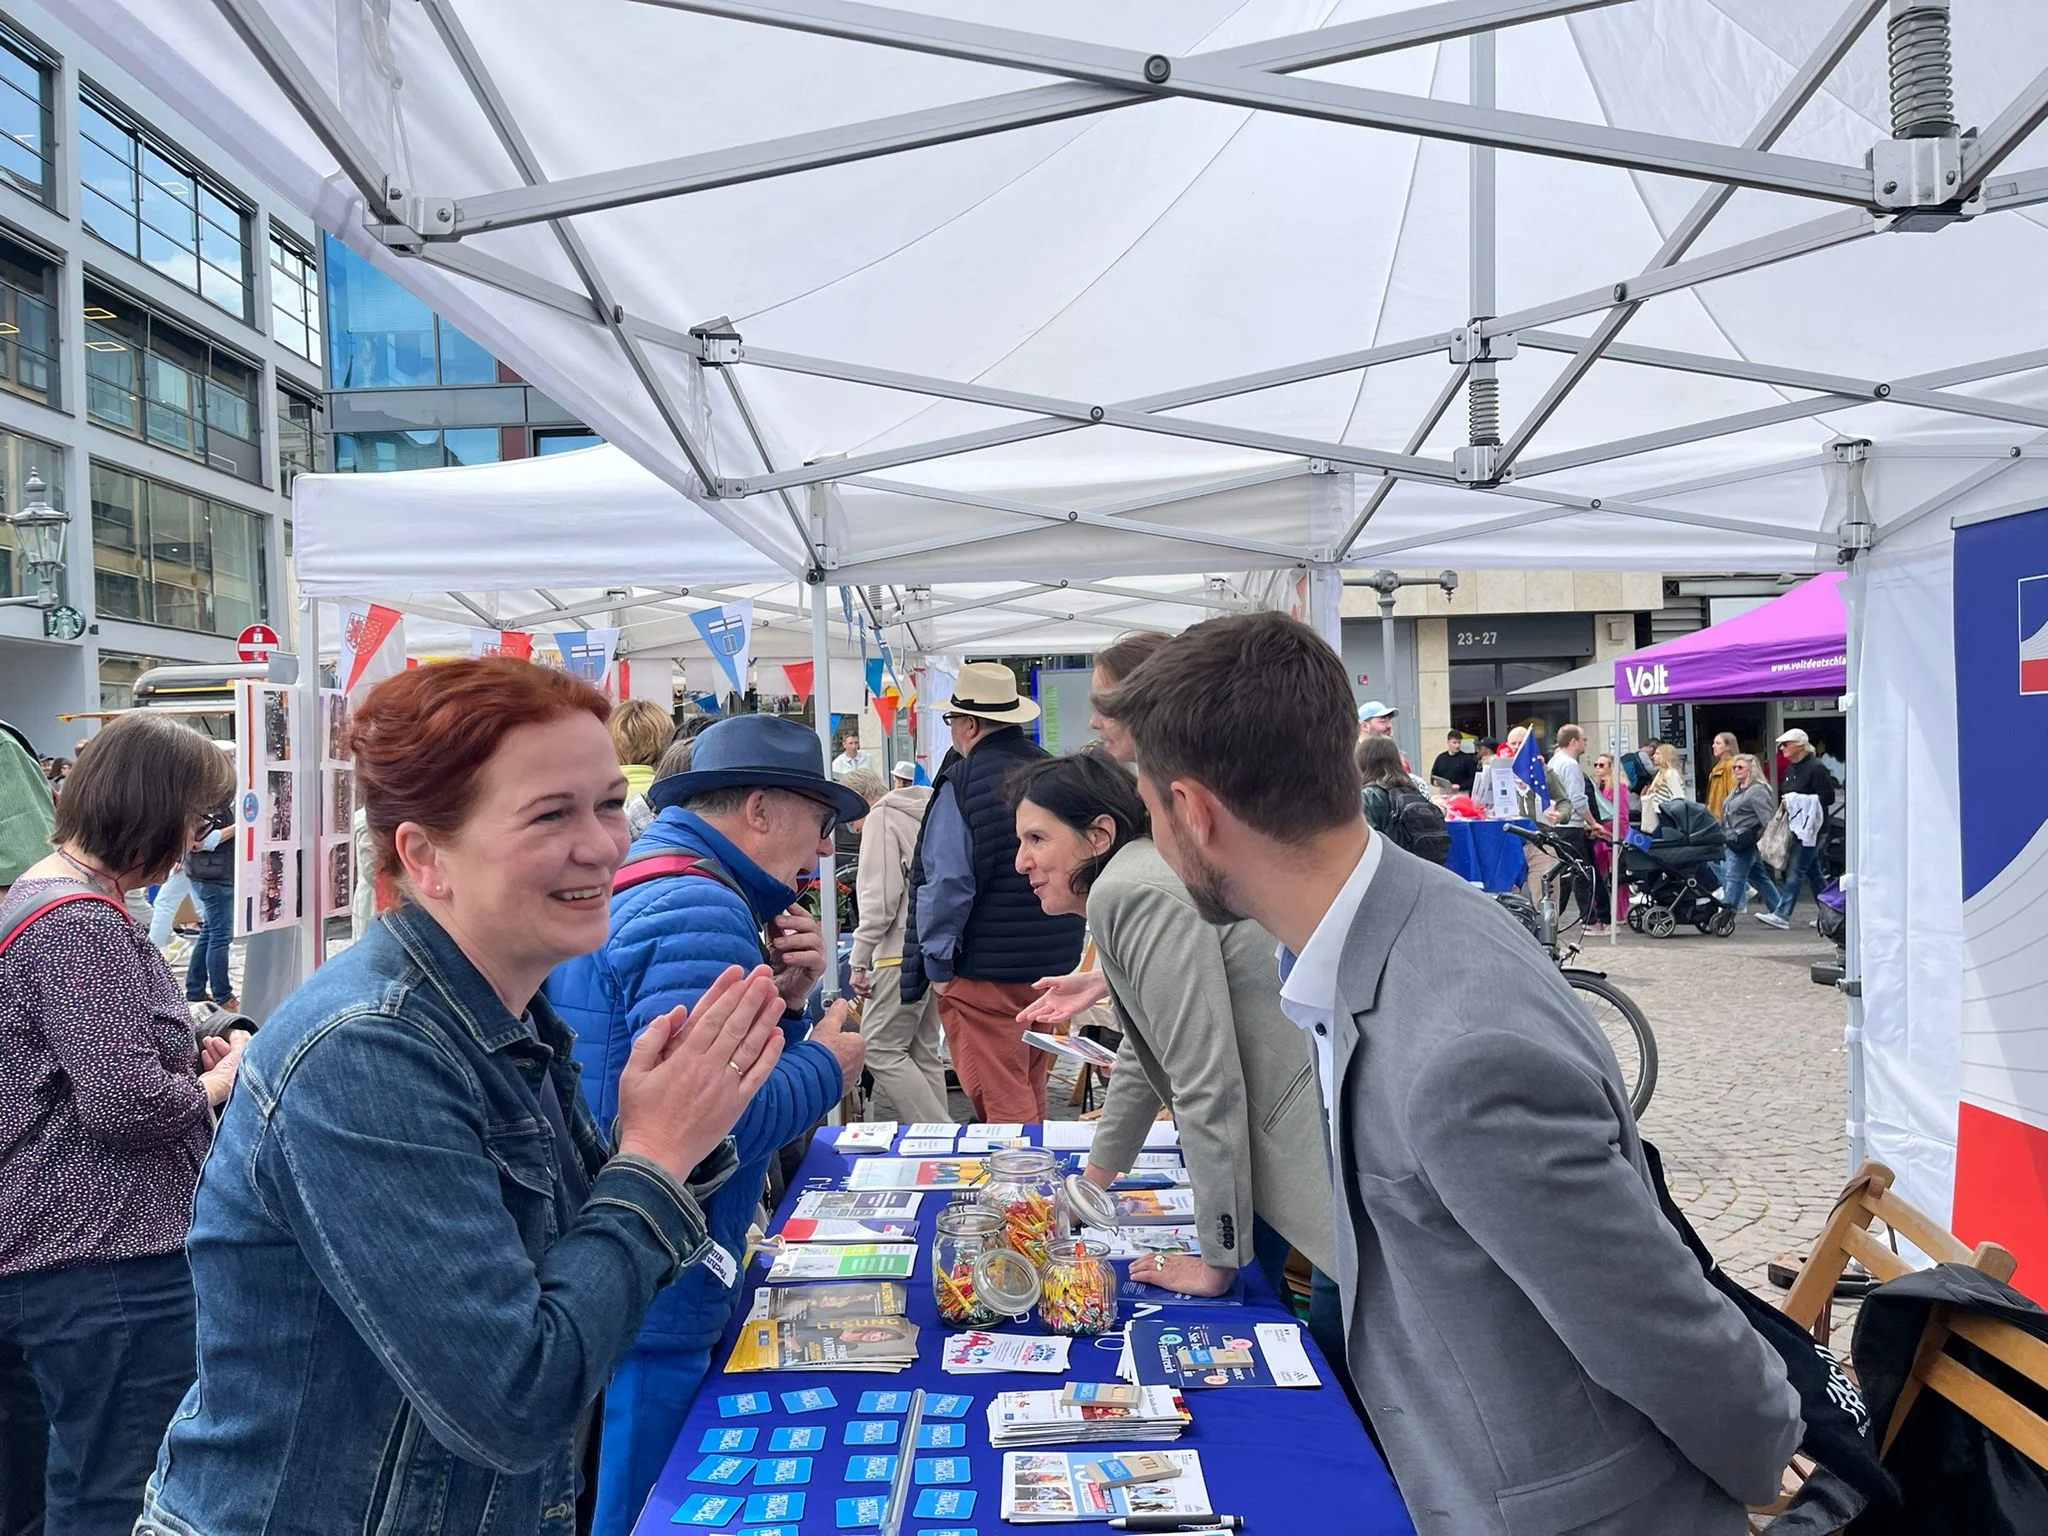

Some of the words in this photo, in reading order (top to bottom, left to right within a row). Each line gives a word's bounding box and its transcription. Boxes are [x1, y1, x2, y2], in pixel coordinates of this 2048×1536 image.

[1457, 632, 1497, 645] 23-27
[1625, 664, 1670, 697] Volt
[816, 1318, 899, 1330] LESUNG
